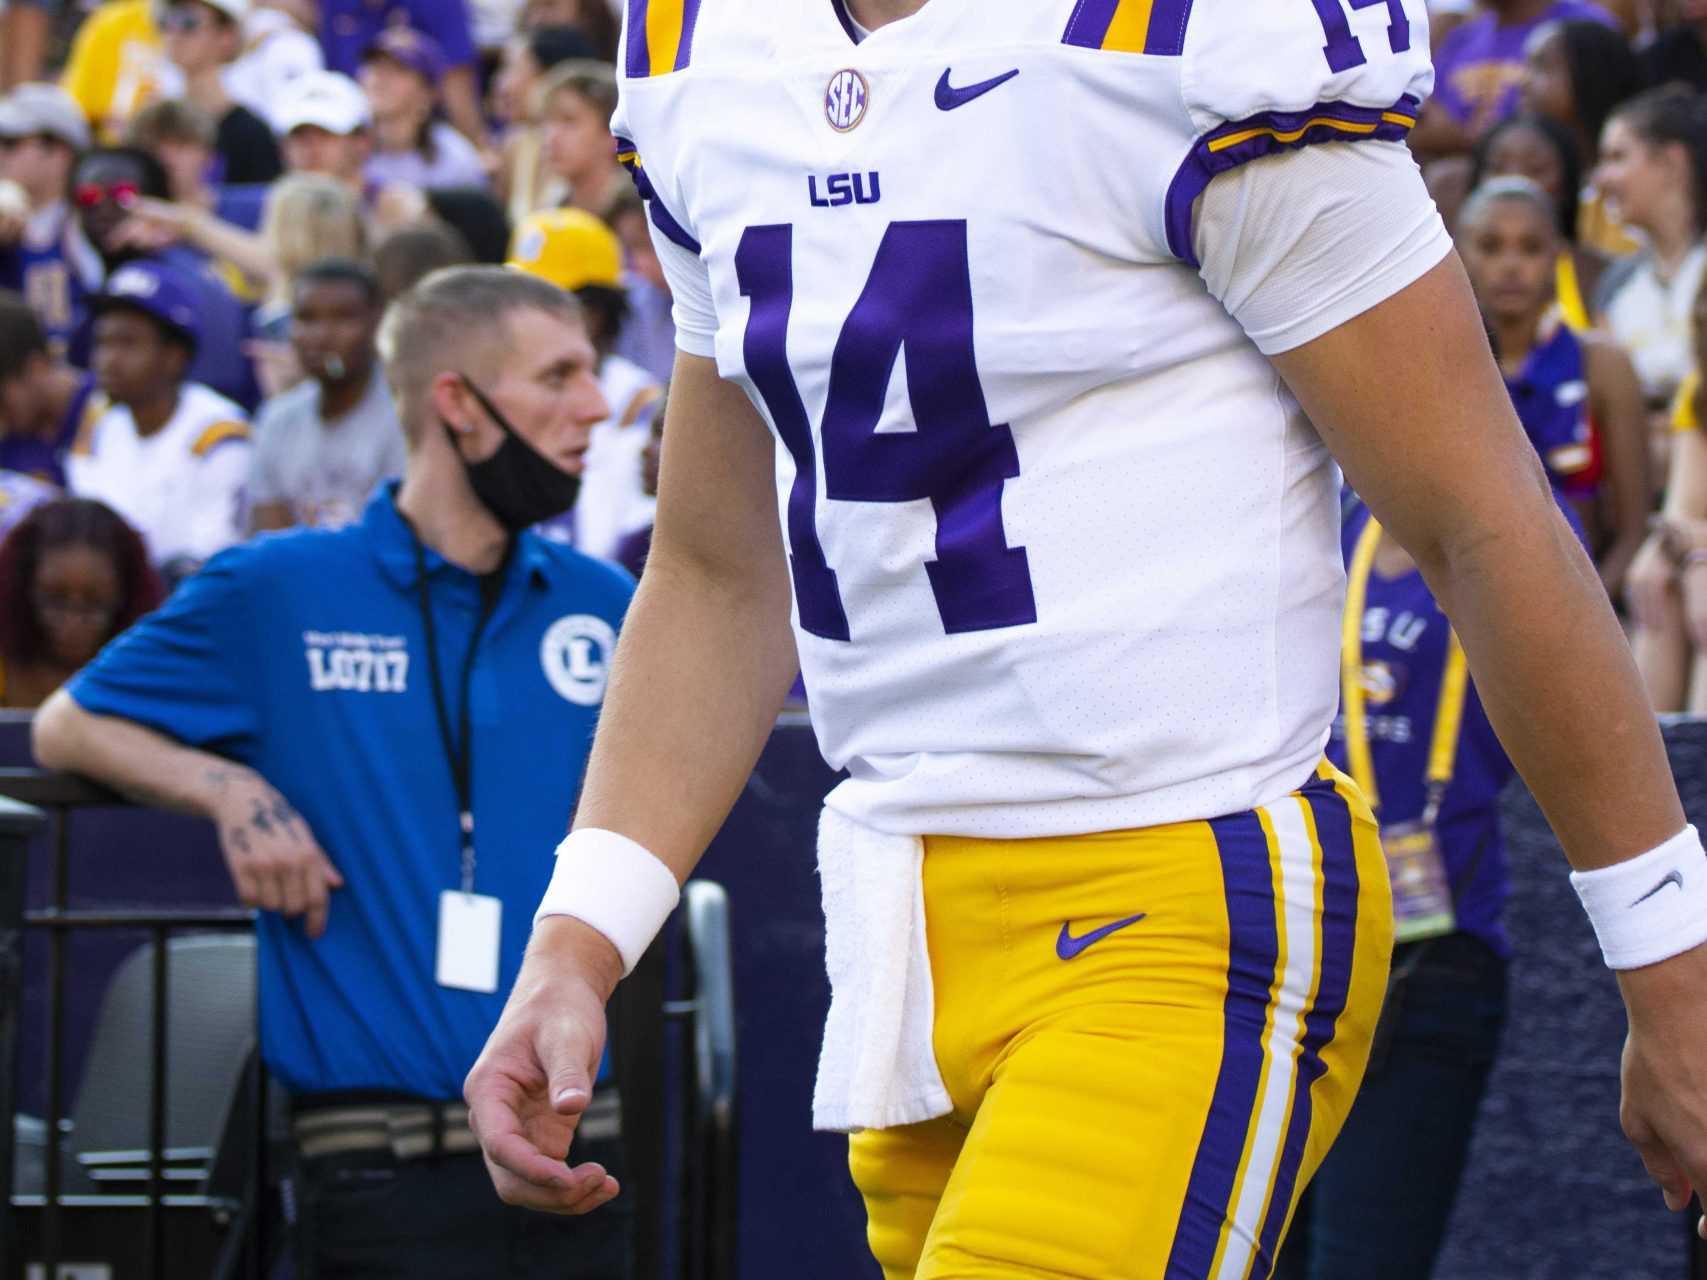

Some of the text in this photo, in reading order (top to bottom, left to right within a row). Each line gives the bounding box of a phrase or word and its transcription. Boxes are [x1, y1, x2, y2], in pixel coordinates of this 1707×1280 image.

[826, 70, 868, 131] SEC
[808, 171, 881, 207] LSU
[735, 219, 1037, 641] 14
[1360, 606, 1428, 651] SU
